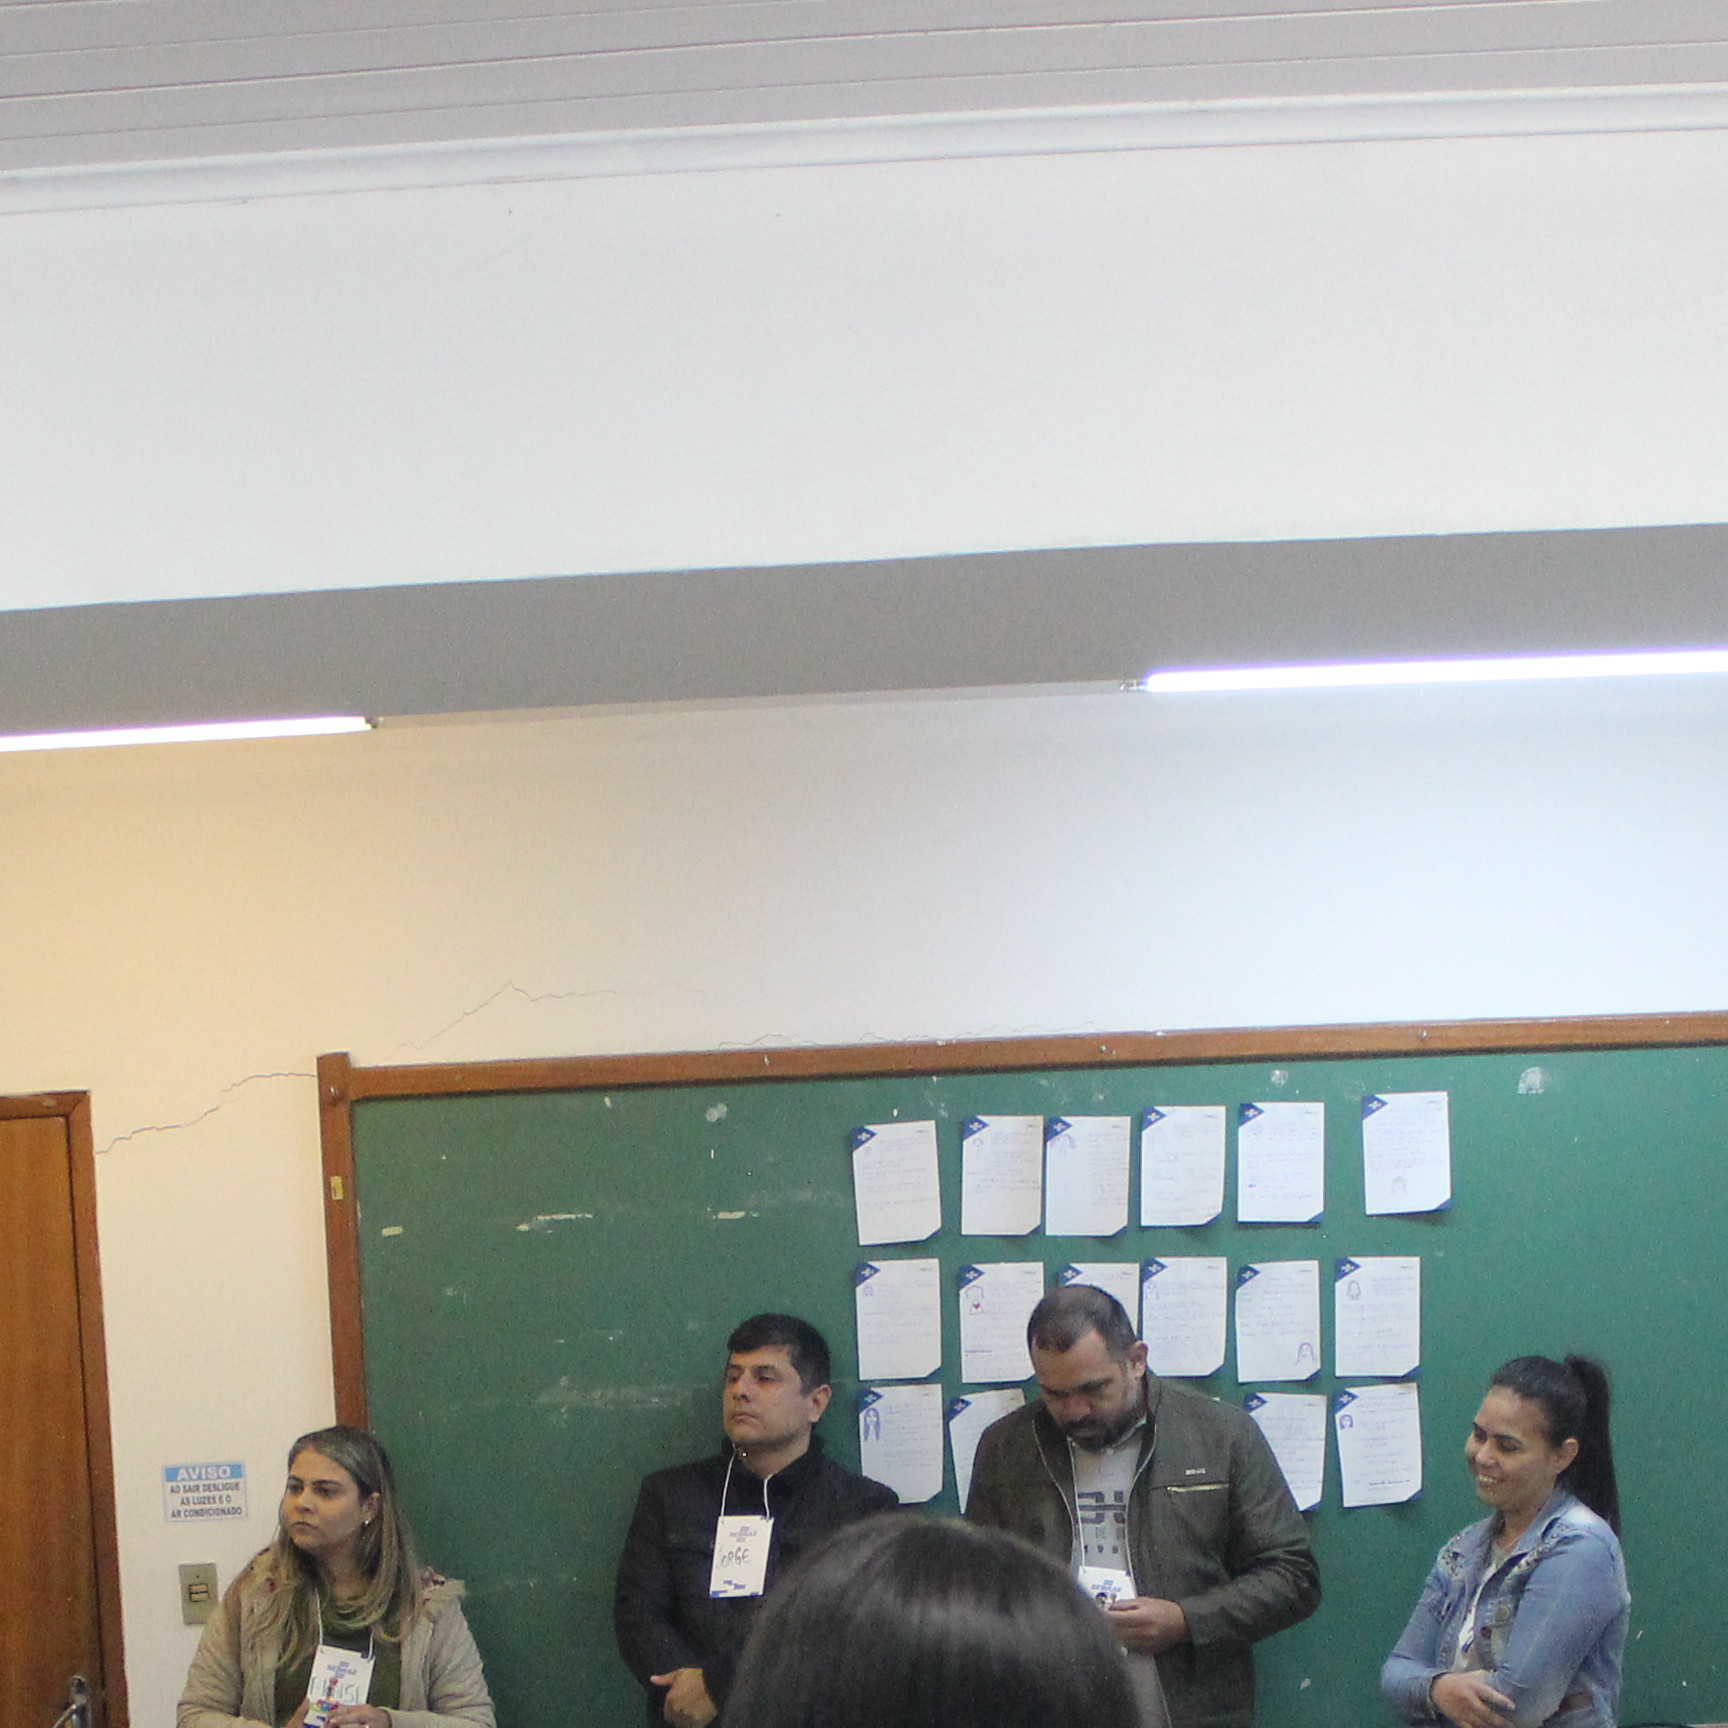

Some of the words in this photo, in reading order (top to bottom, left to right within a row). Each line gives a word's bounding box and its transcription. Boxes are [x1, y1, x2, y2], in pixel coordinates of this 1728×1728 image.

[177, 1465, 232, 1481] AVISO
[169, 1484, 181, 1494] AO
[182, 1484, 201, 1494] SAIR
[202, 1482, 241, 1493] DESLIGUE
[180, 1496, 191, 1506] AS
[192, 1495, 217, 1505] LUZES
[171, 1509, 182, 1518] AR
[183, 1506, 243, 1518] CONDICIONADO
